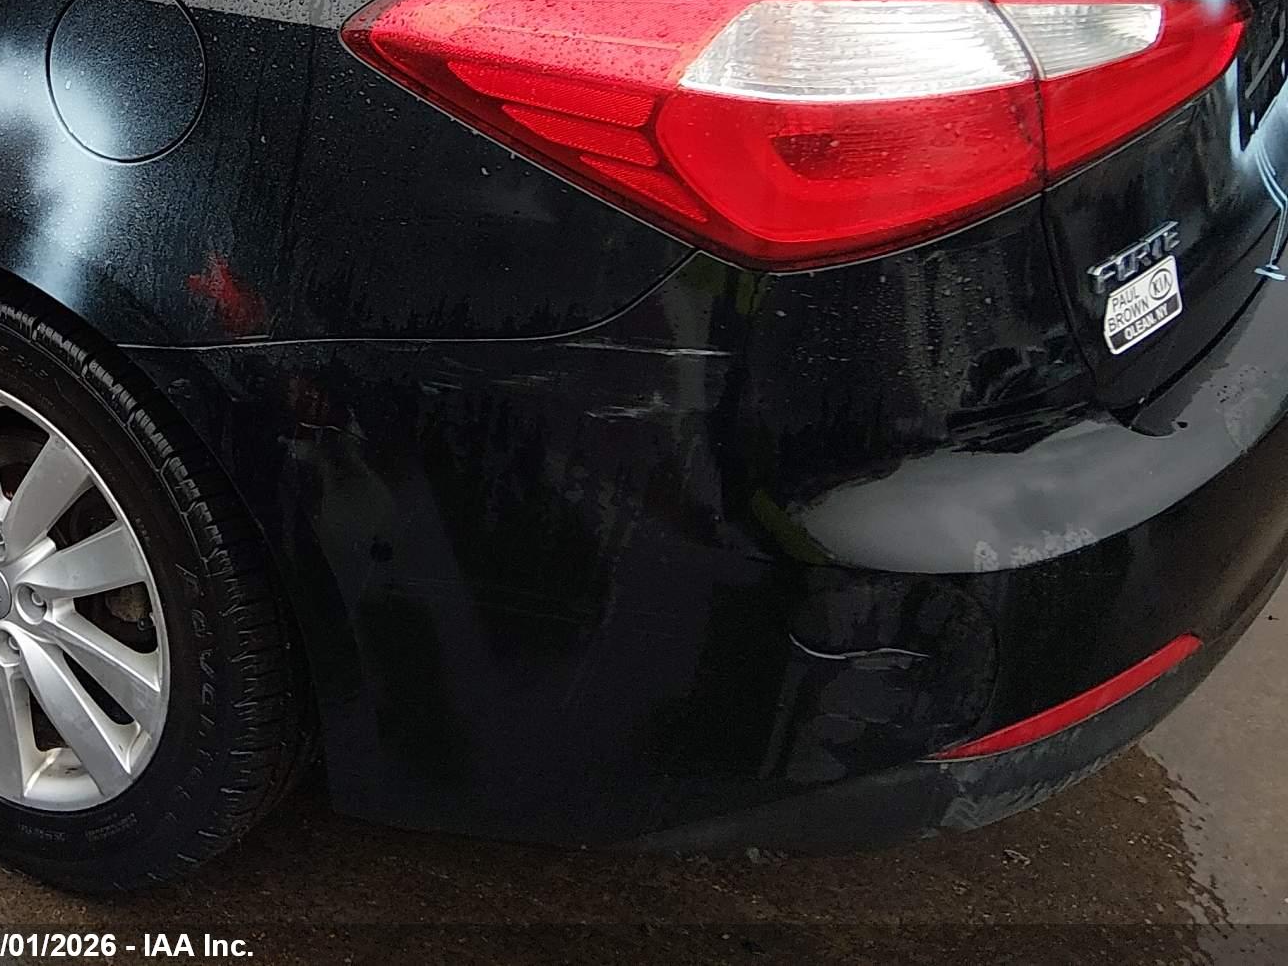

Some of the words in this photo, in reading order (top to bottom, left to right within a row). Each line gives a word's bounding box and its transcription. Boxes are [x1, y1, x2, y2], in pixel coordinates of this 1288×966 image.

[1087, 221, 1180, 294] FORTE
[1107, 295, 1150, 333] BROWN
[1111, 286, 1141, 313] PAUL
[1155, 302, 1169, 321] NY
